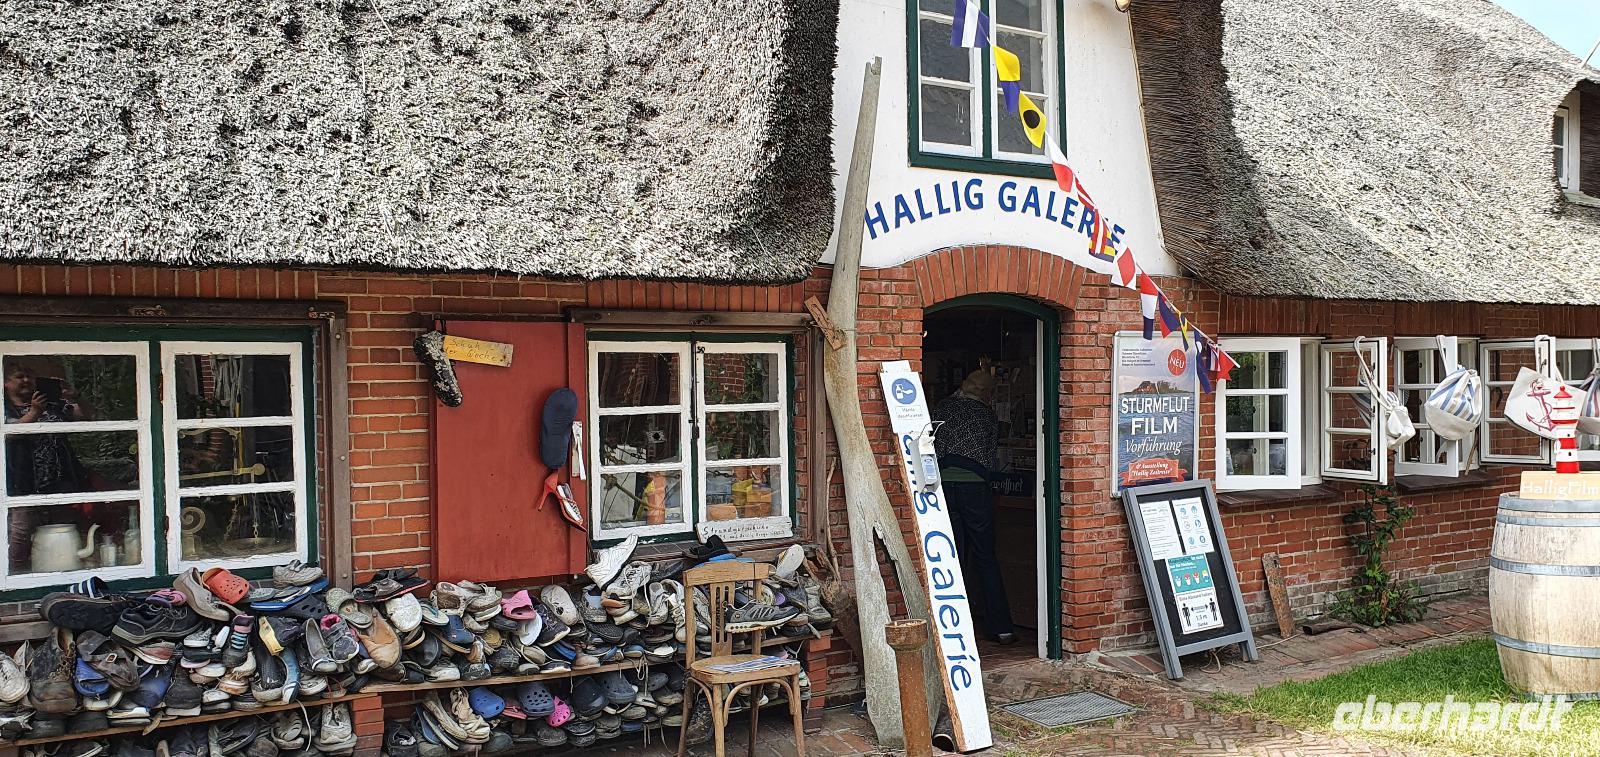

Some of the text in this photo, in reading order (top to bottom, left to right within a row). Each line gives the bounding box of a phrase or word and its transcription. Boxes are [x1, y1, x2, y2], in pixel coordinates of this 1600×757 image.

[864, 178, 1126, 254] HALLIG GALERE
[1169, 355, 1185, 369] NEU
[1121, 396, 1190, 414] STURMFLUT
[1131, 416, 1178, 435] FILM
[1125, 436, 1183, 457] Vorführung
[924, 530, 976, 691] Galerie
